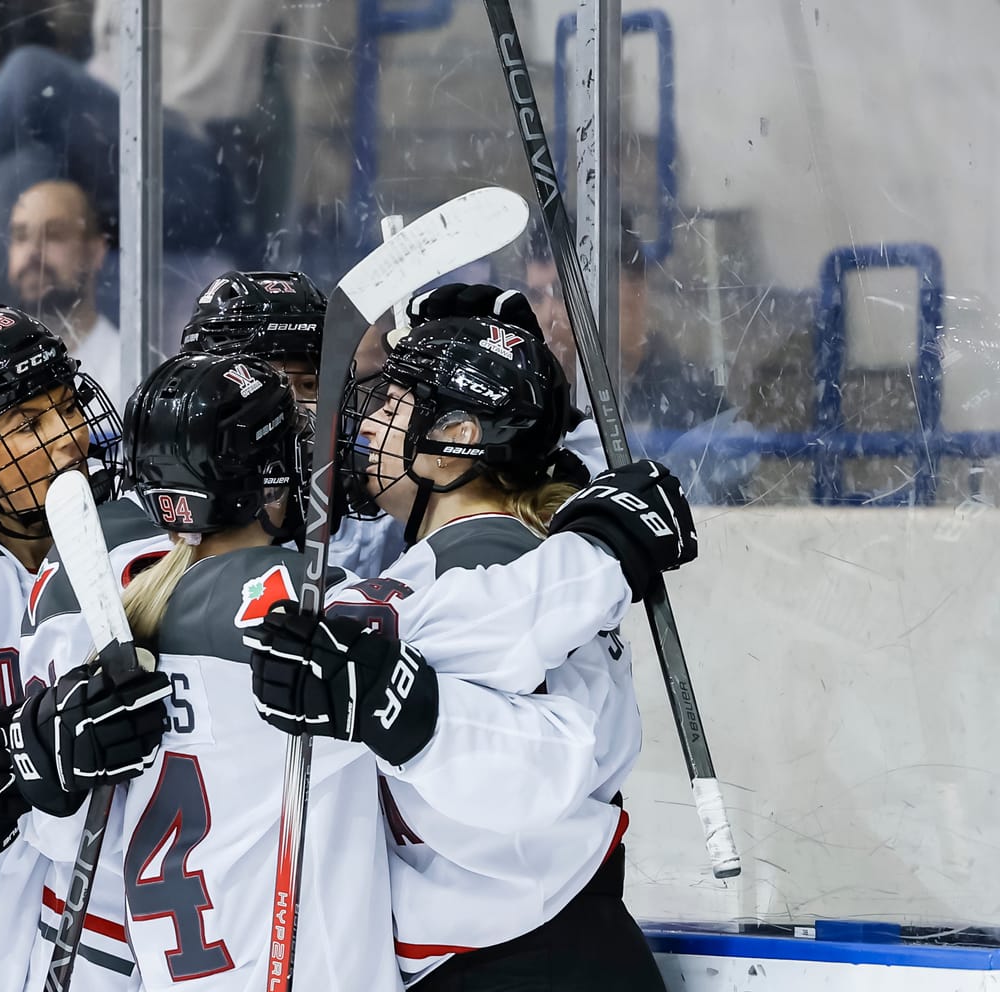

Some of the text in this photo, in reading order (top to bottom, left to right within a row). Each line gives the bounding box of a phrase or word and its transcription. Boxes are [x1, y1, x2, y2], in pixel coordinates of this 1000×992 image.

[499, 33, 560, 209] VAPOR
[264, 280, 297, 293] 21
[267, 322, 318, 331] BAUER
[15, 348, 57, 374] CCM
[158, 495, 194, 523] 94
[680, 681, 700, 732] BAUER
[125, 751, 234, 984] 4
